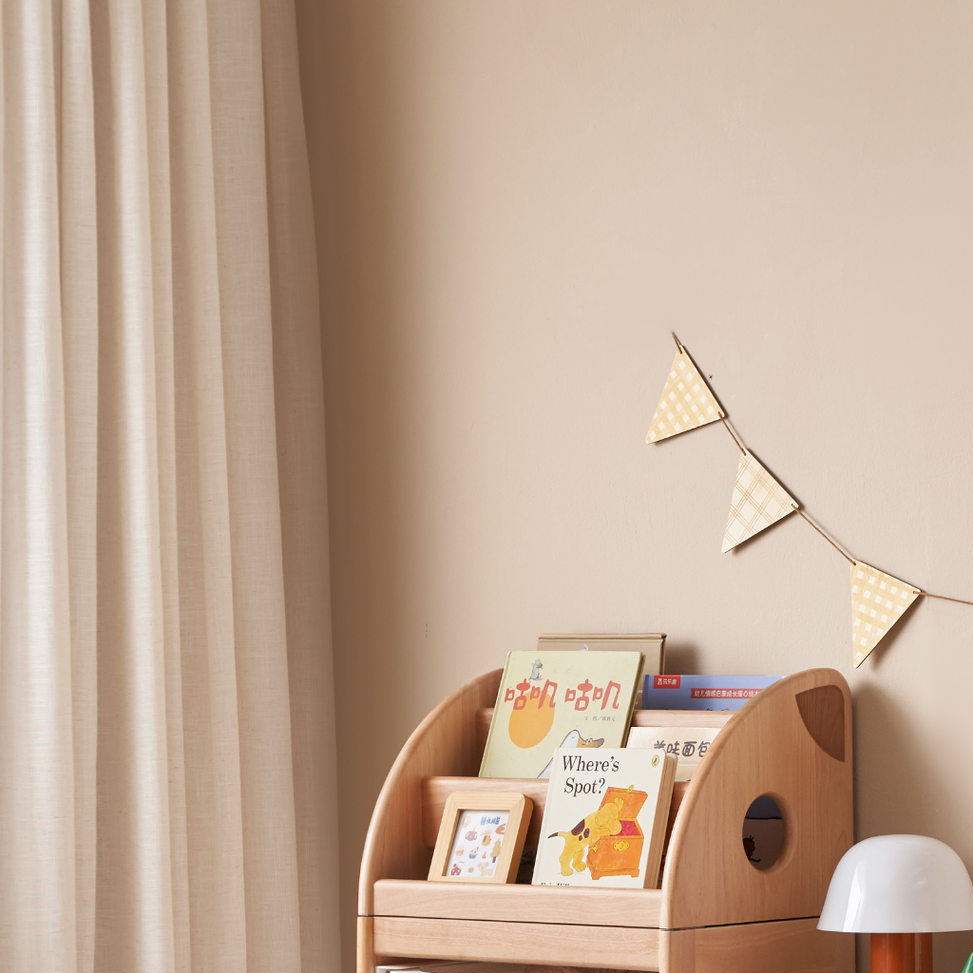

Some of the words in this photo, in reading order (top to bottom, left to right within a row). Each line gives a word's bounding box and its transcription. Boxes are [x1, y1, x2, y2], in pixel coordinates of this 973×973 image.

[504, 678, 558, 711] 咕叽
[564, 678, 621, 711] 咕叽
[562, 755, 620, 772] Where's
[563, 777, 606, 797] Spot?
